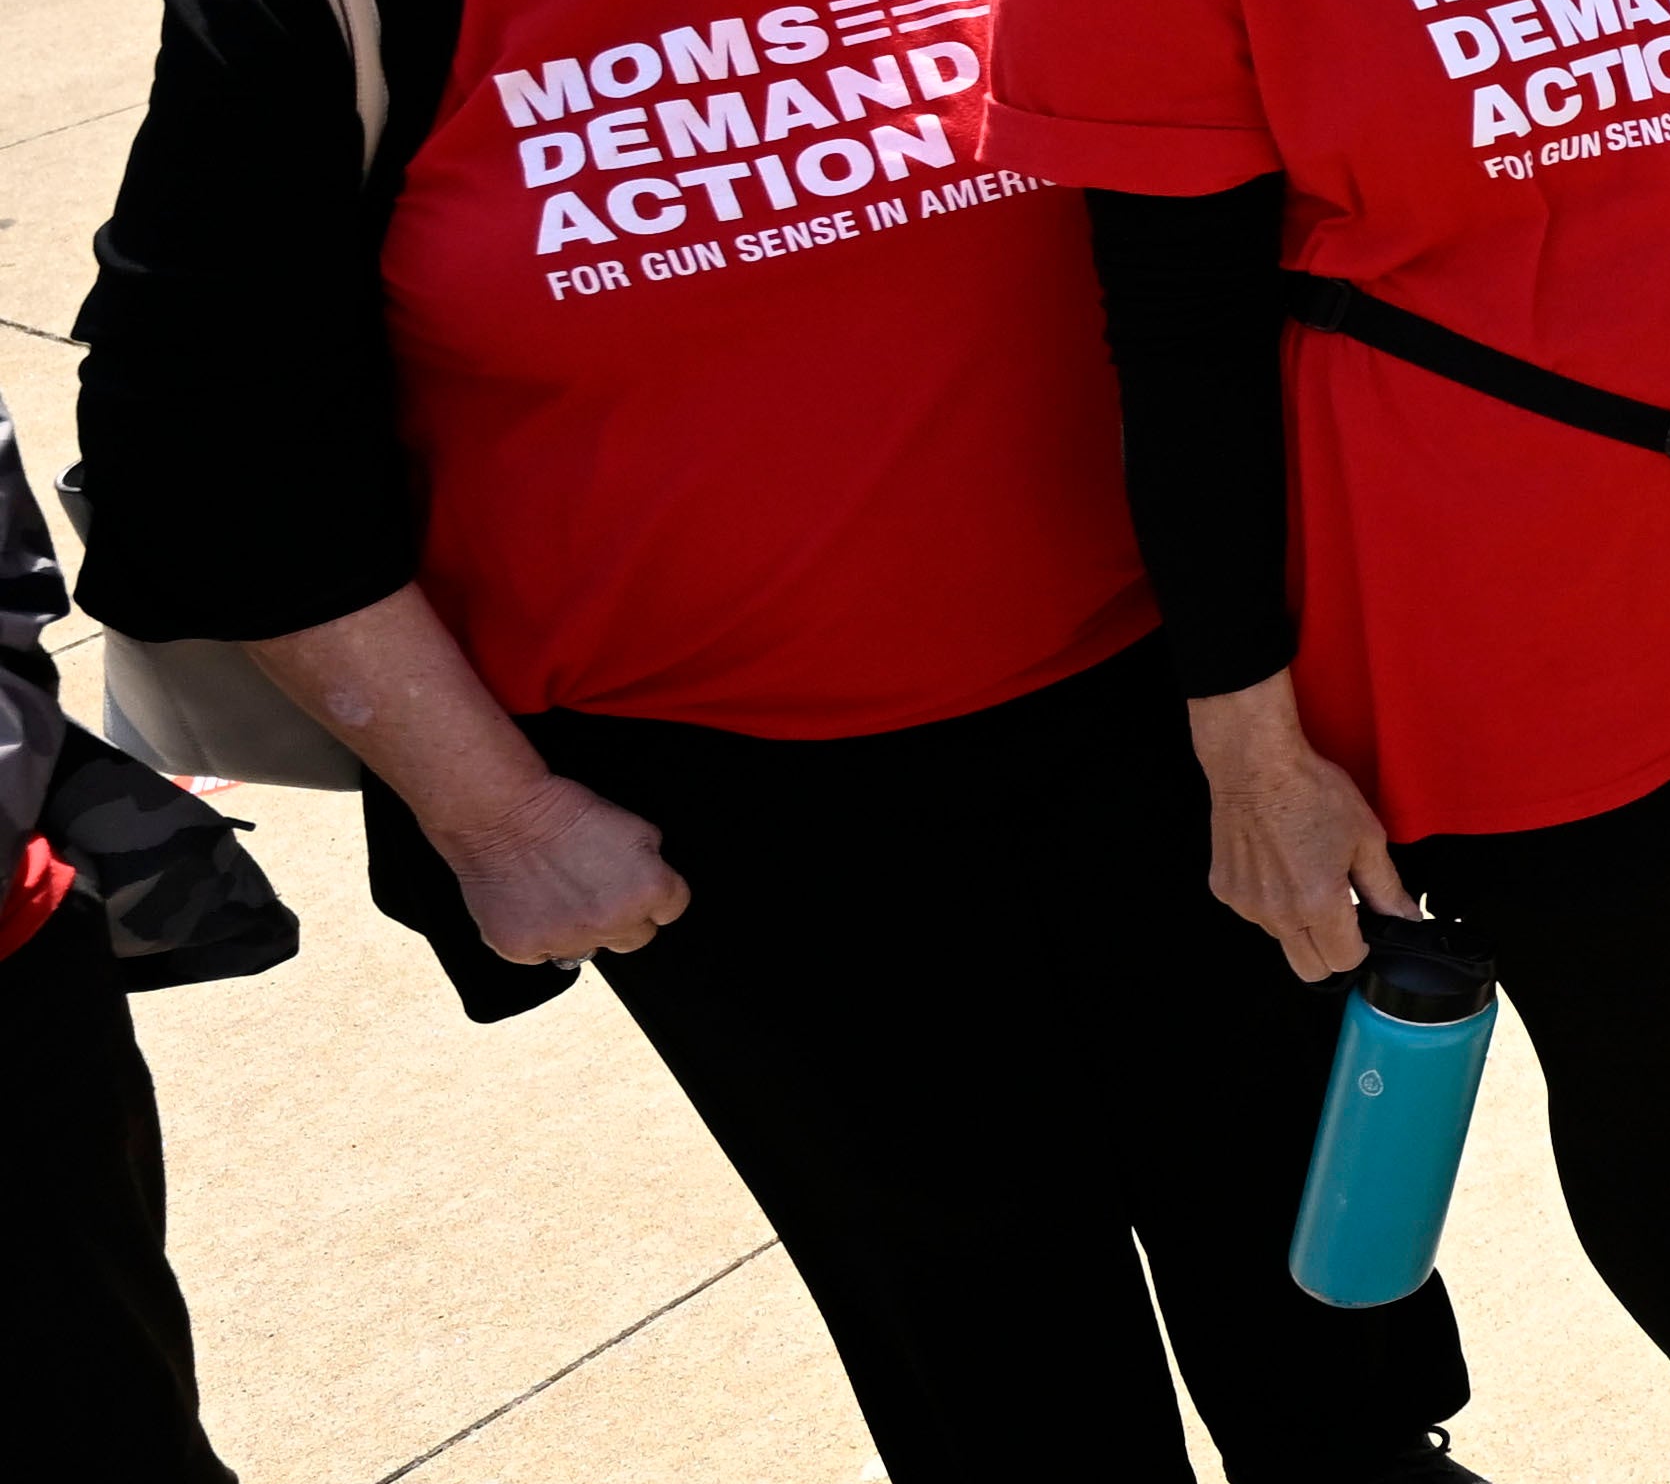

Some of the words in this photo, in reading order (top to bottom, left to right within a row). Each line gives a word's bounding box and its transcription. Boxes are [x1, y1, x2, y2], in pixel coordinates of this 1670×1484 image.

[493, 6, 830, 128] MOMS
[519, 40, 981, 190] DEMAND
[536, 113, 956, 255] ACTION
[1540, 129, 1602, 167] GUN
[546, 260, 631, 301] FOR
[640, 241, 727, 282] GUN
[735, 210, 860, 262] SENSE
[866, 197, 908, 232] IN
